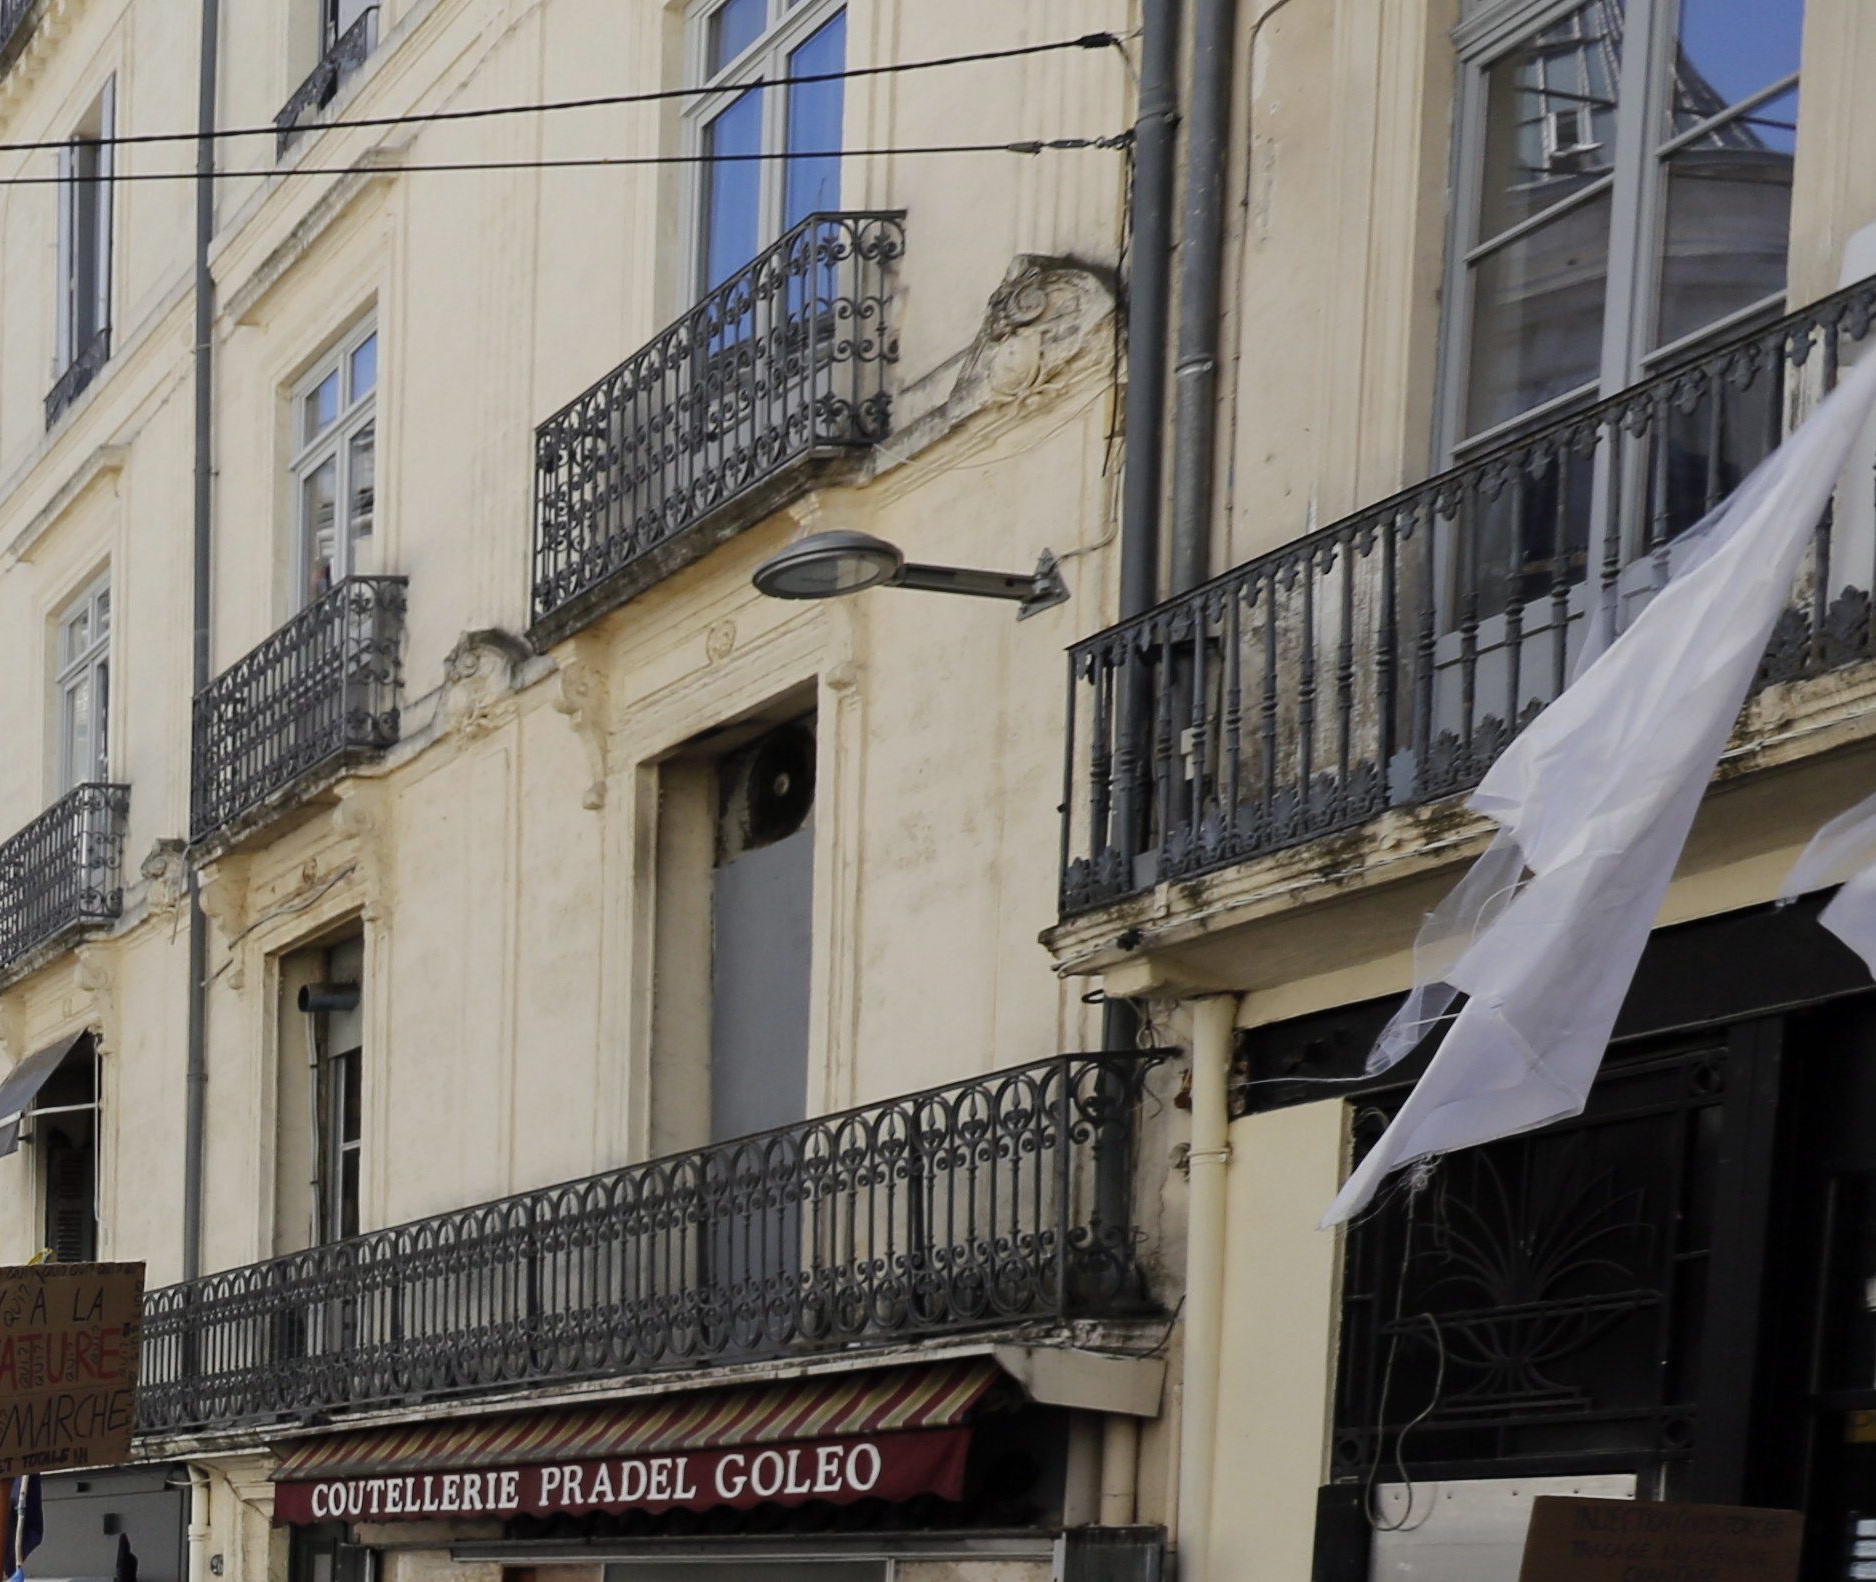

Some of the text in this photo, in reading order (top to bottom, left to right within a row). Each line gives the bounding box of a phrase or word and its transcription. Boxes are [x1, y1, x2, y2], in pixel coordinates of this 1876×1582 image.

[72, 1286, 104, 1322] LA
[0, 1388, 134, 1450] MARCHE
[310, 1442, 882, 1518] COUTELLERIE PRADEL GOLEO
